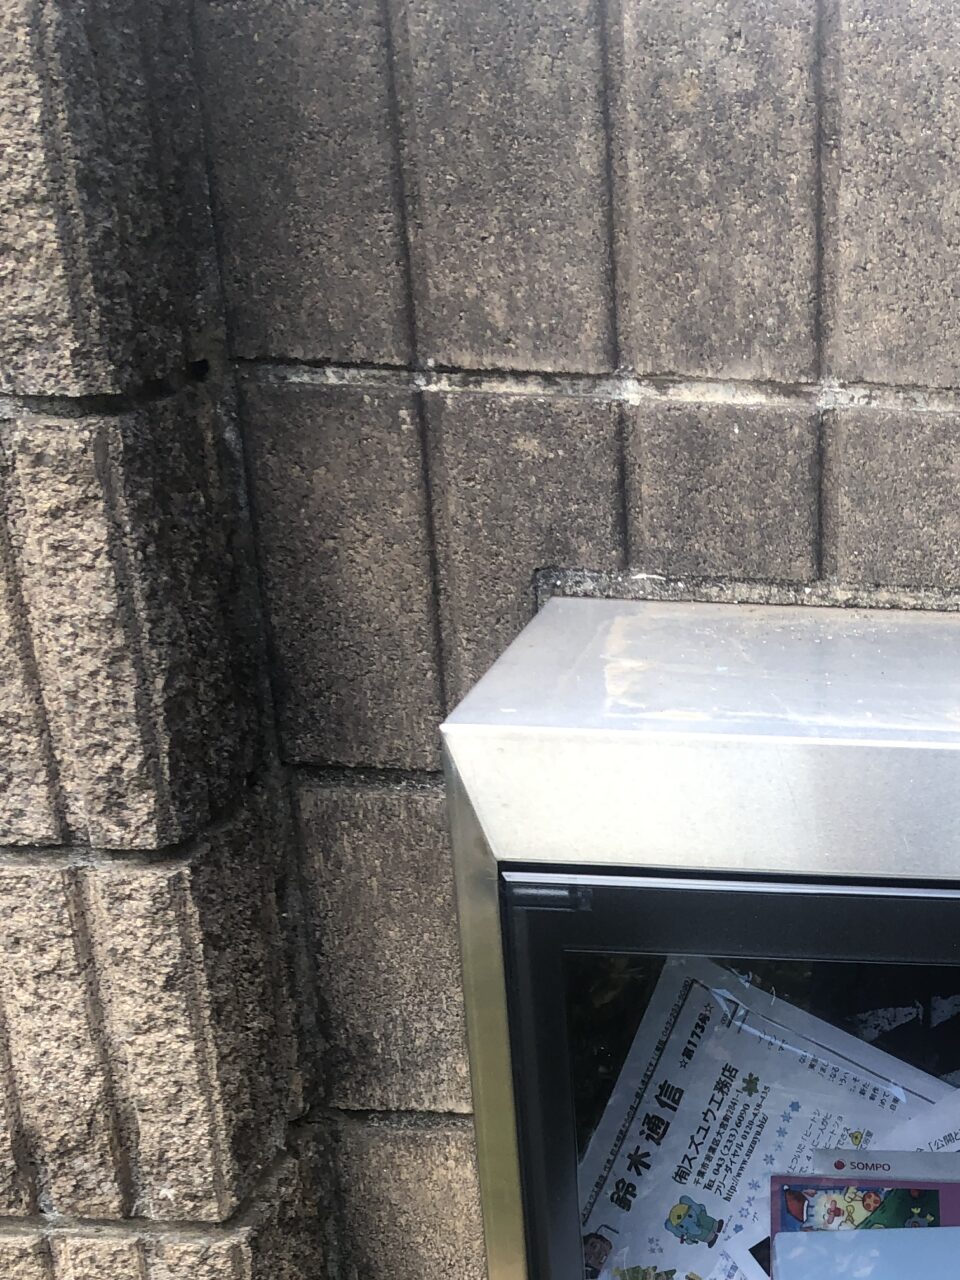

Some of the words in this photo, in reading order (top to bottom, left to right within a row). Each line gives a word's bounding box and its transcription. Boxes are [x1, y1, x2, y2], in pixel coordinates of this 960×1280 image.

[610, 1080, 685, 1211] 鈴木通信
[714, 1142, 743, 1196] フリーダイヤル
[722, 1113, 768, 1202] http://www.suzuyu.biz/
[850, 1161, 891, 1172] SOMPO
[703, 1179, 716, 1190] TEL
